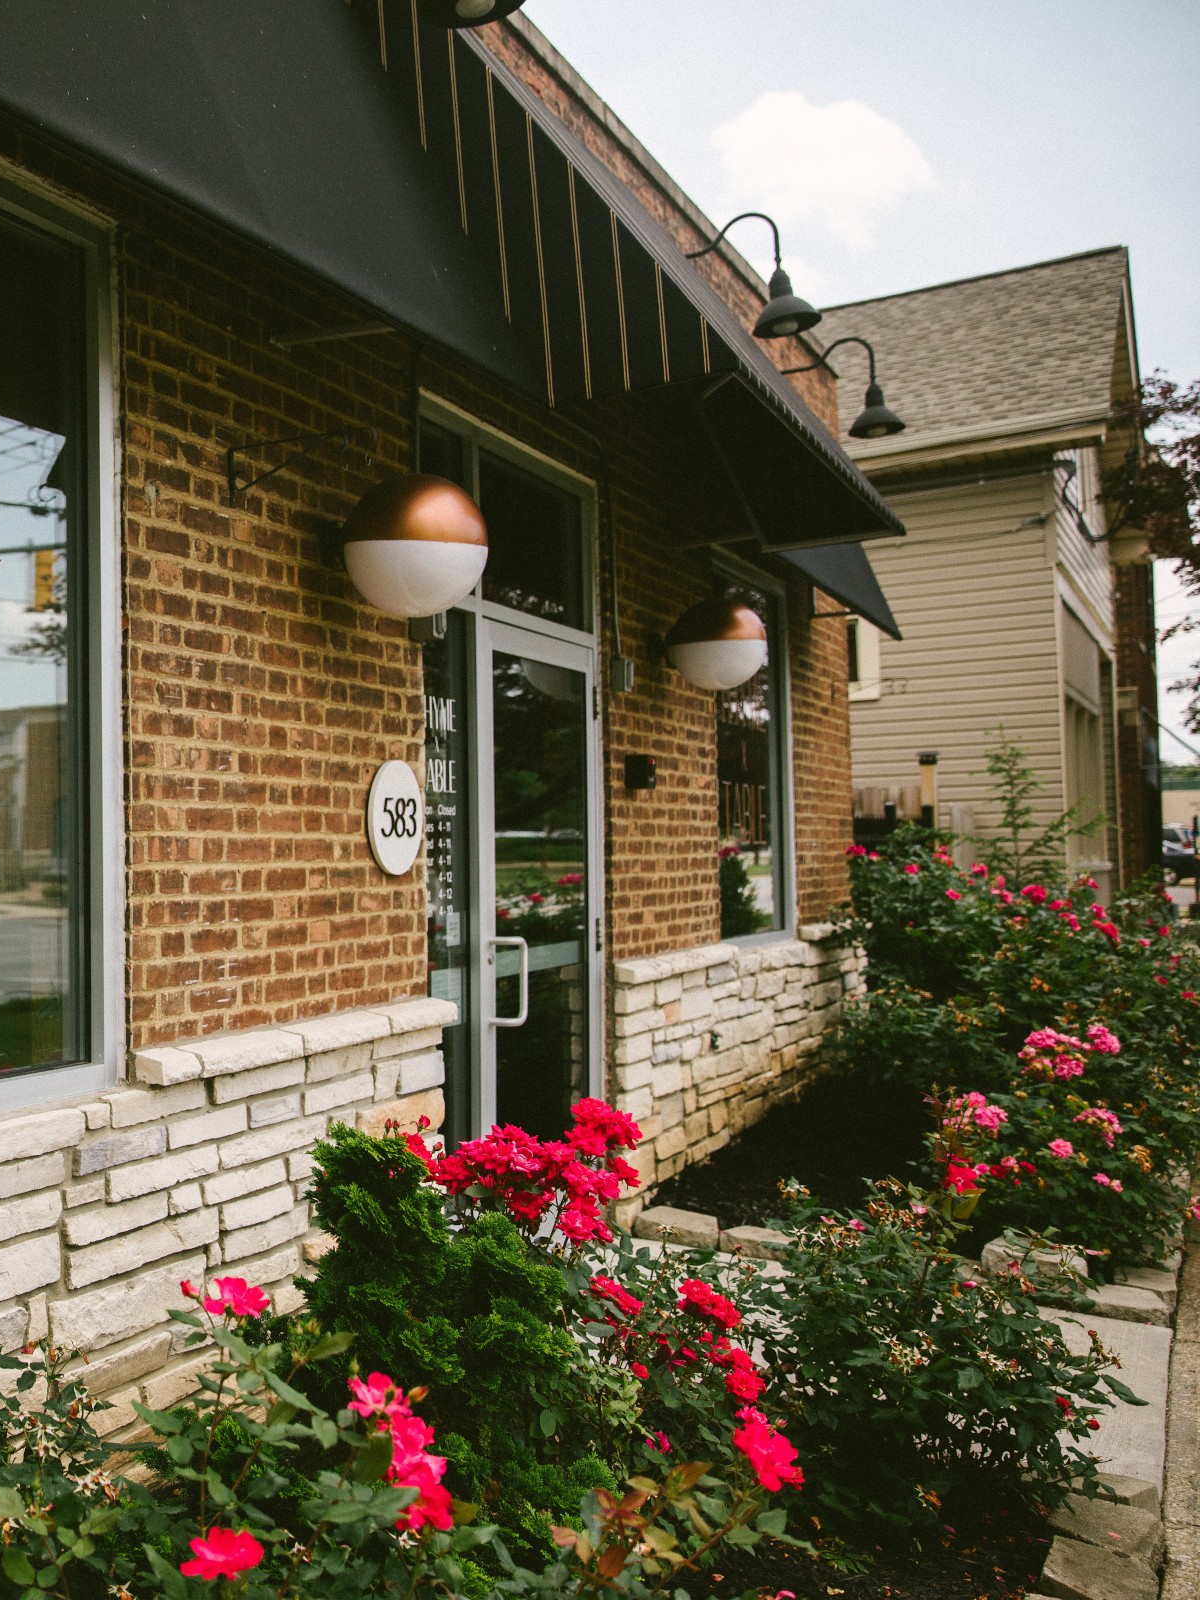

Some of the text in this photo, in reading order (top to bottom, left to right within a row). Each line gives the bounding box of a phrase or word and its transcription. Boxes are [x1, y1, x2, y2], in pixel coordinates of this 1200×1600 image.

[423, 694, 457, 732] HYME
[425, 758, 457, 794] ABLE
[381, 797, 417, 838] 583
[437, 803, 457, 817] Closed
